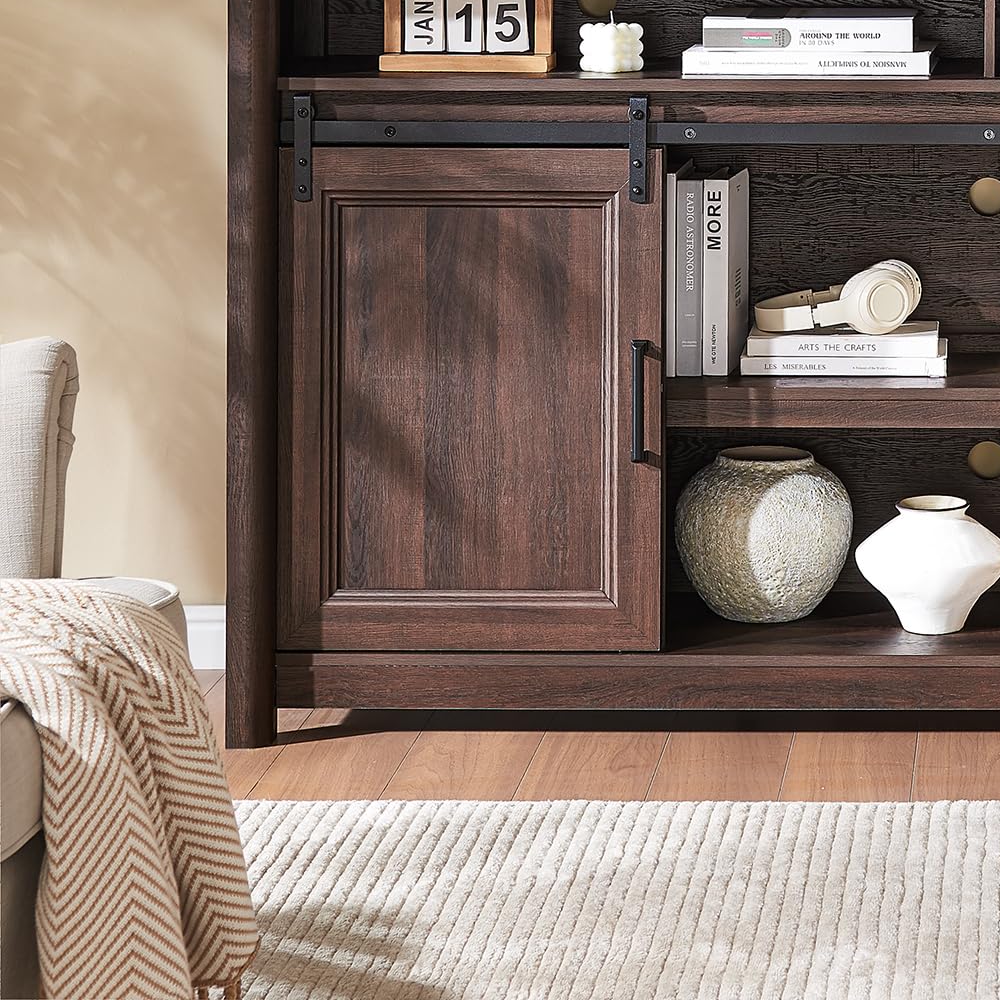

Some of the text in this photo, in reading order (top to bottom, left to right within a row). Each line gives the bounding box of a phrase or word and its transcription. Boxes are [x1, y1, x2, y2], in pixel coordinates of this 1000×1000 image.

[413, 1, 434, 45] JAN
[799, 32, 833, 40] AROUND
[853, 32, 881, 40] WORLD
[859, 60, 871, 68] TO
[873, 60, 907, 68] MANSION
[707, 190, 722, 250] MORE
[685, 192, 696, 292] RADIO ASTRONOMER
[798, 343, 877, 352] ARTS THE CRAFTS
[781, 363, 827, 371] MISERABLES
